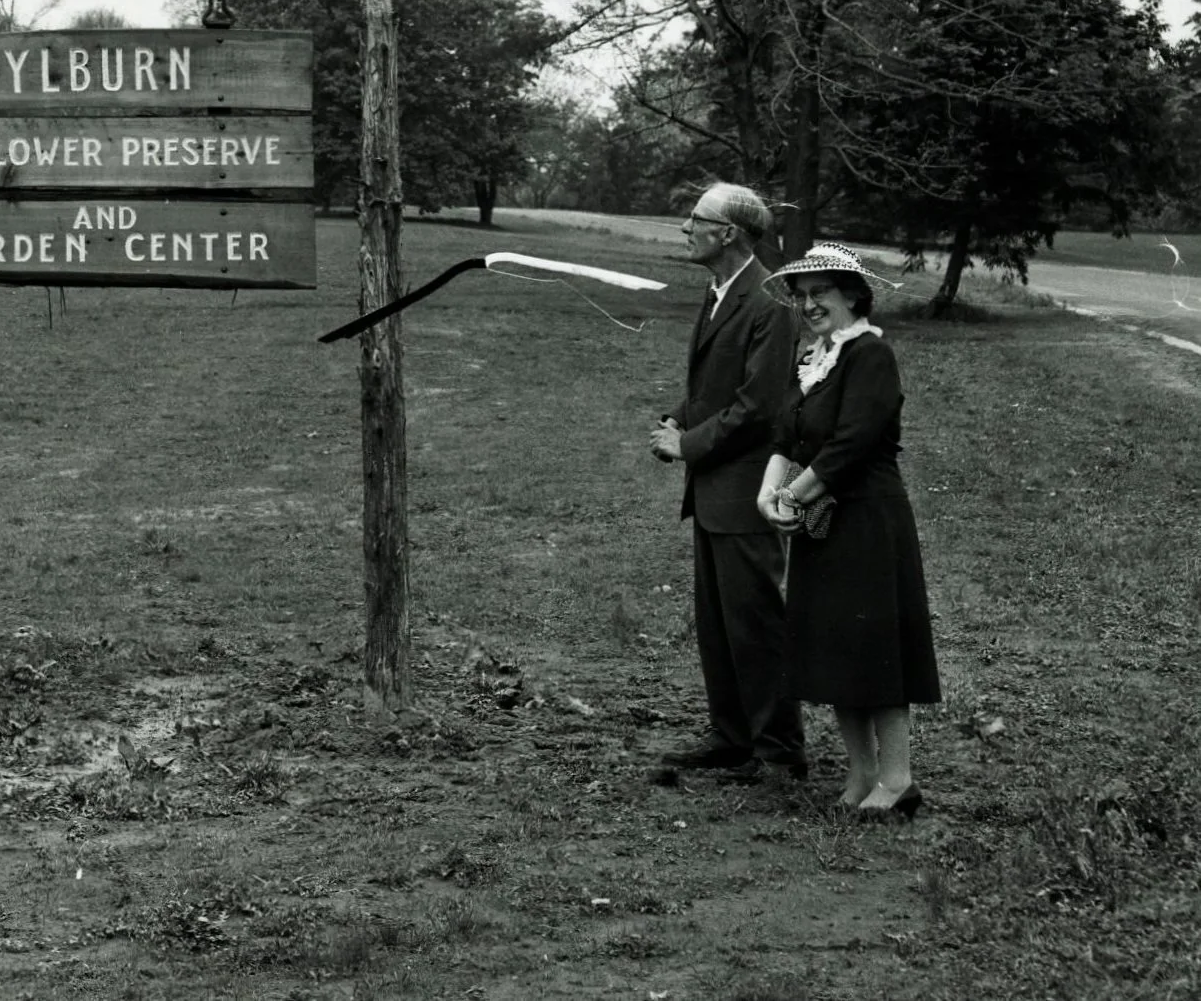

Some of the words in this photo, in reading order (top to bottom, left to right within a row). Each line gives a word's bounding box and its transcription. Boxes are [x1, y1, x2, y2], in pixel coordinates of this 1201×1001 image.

[121, 135, 282, 166] PRESERVE
[72, 205, 138, 231] AND
[124, 232, 270, 262] CENTER
